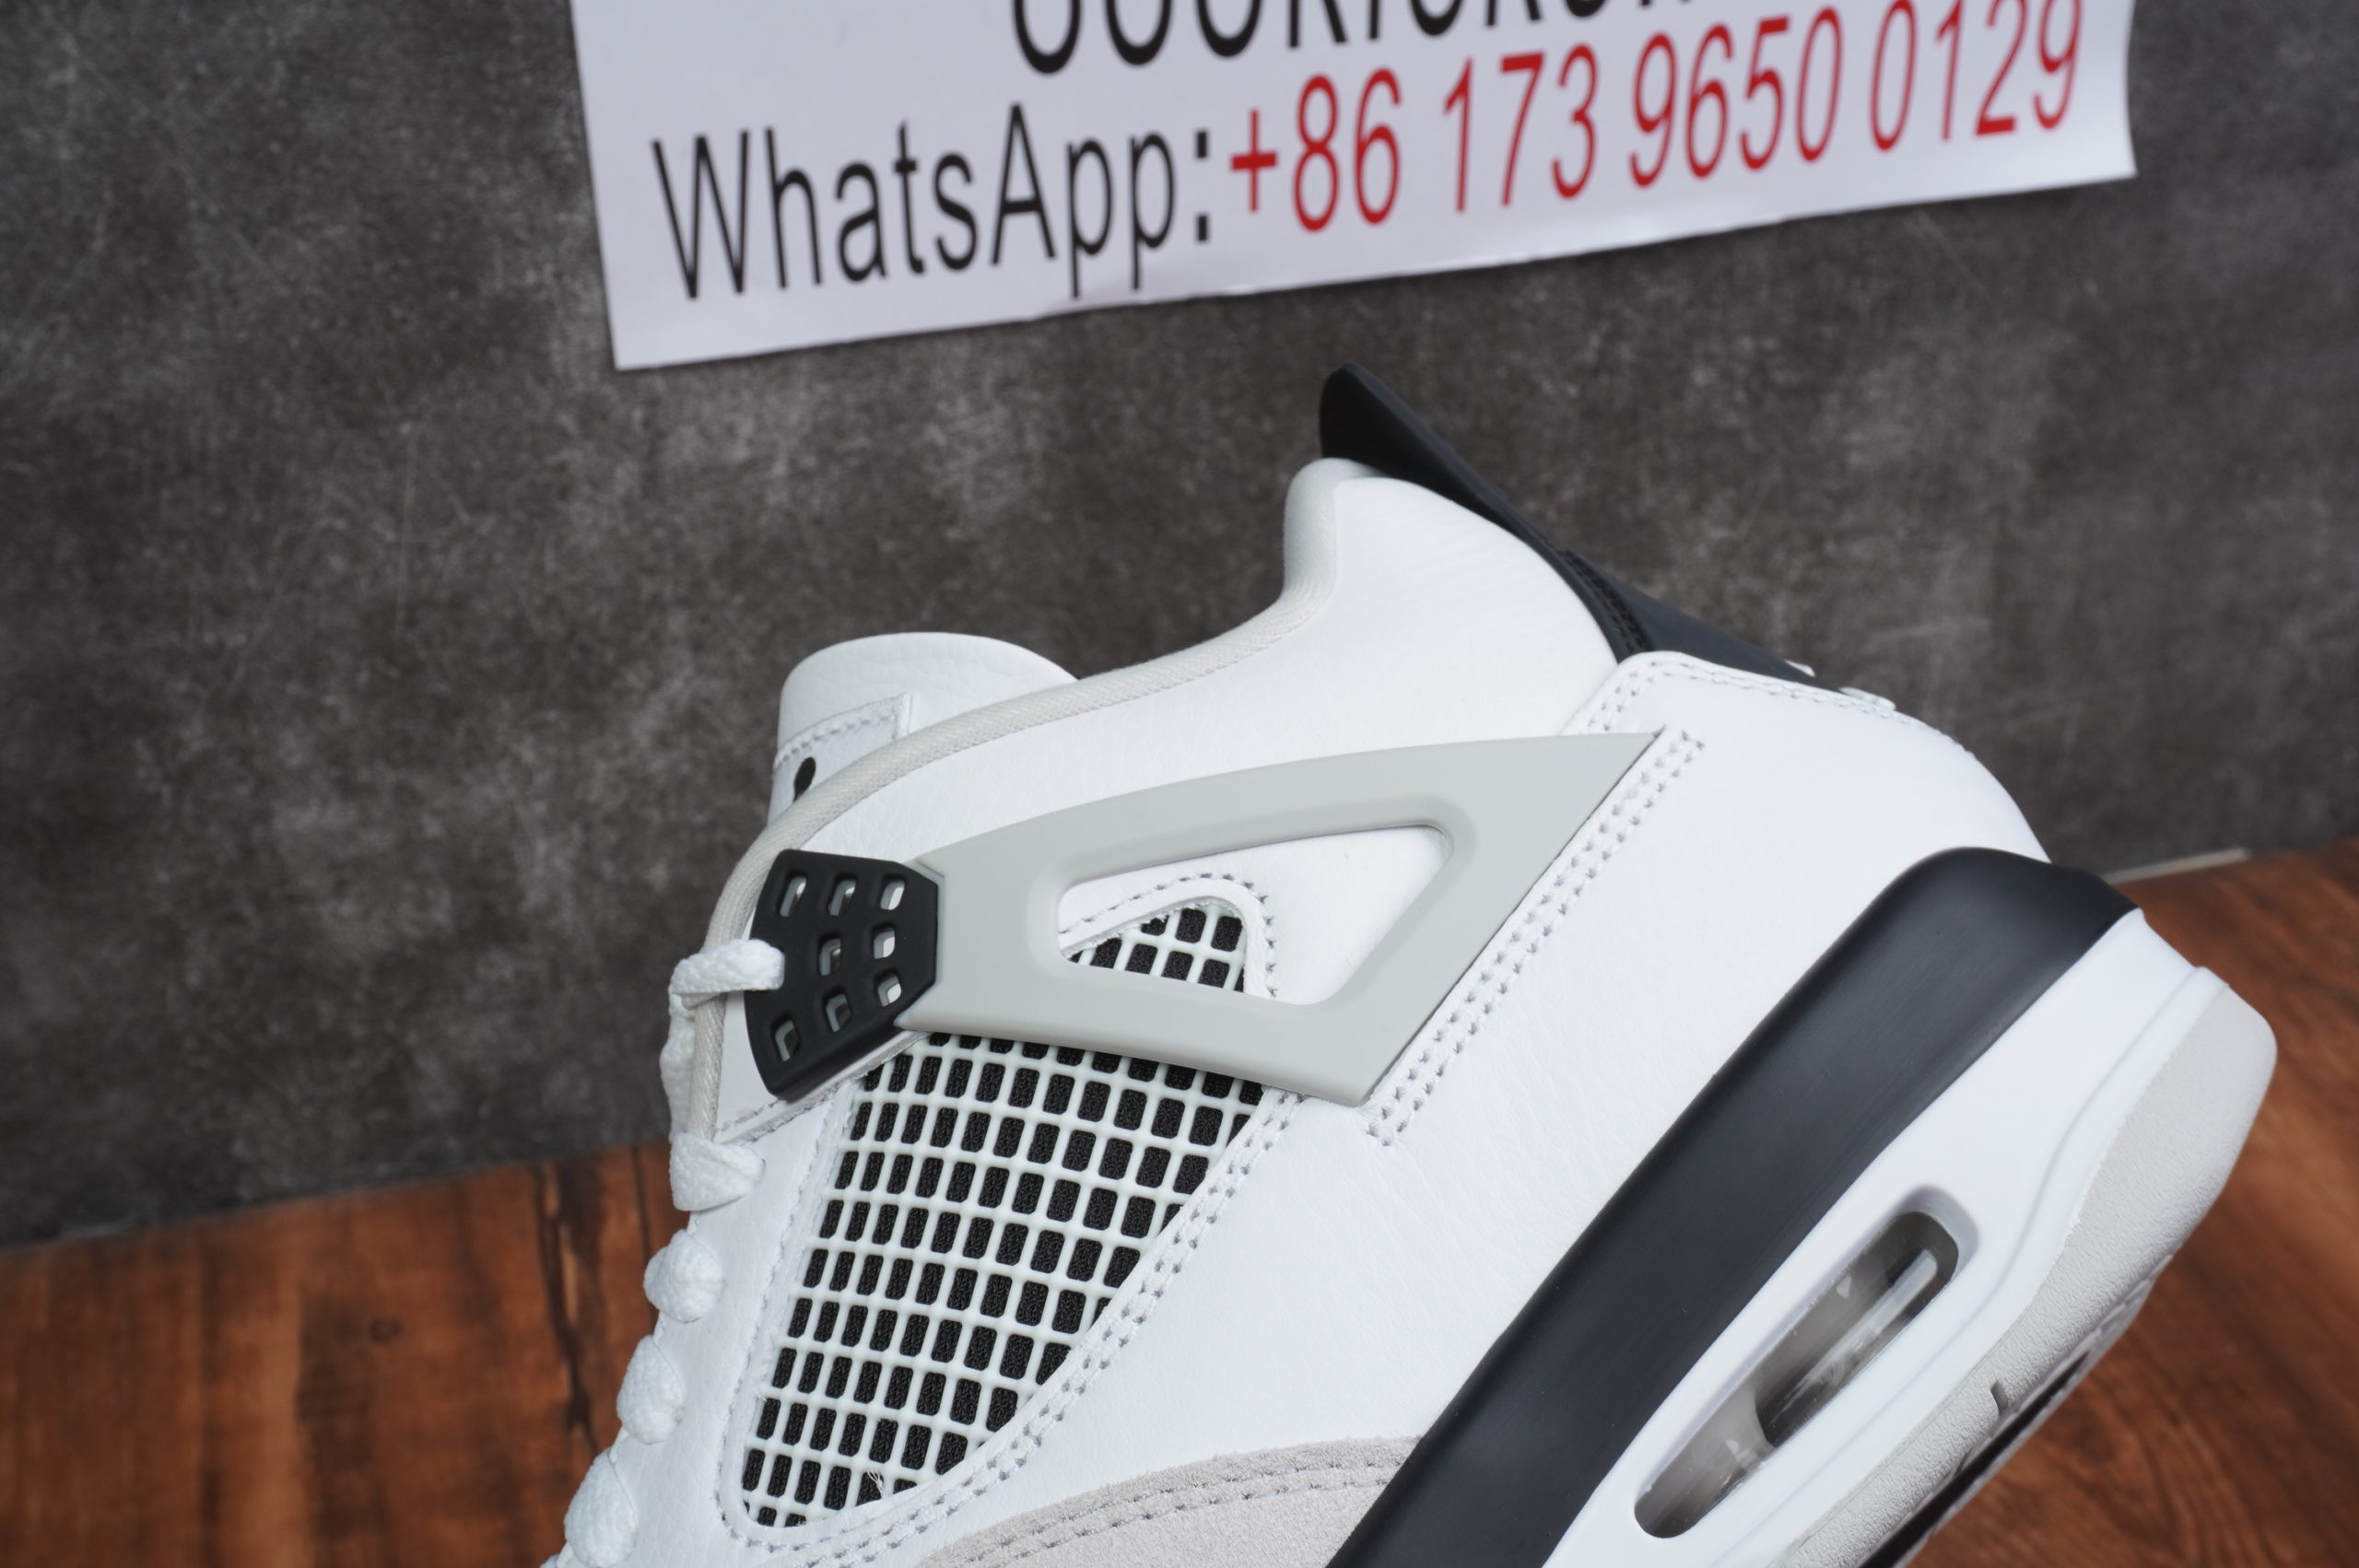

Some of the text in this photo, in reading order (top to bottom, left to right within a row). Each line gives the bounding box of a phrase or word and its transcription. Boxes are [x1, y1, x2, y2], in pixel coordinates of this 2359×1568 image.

[1443, 41, 1600, 214] 173
[1627, 5, 1845, 191] 9650
[1869, 0, 2083, 155] 0129
